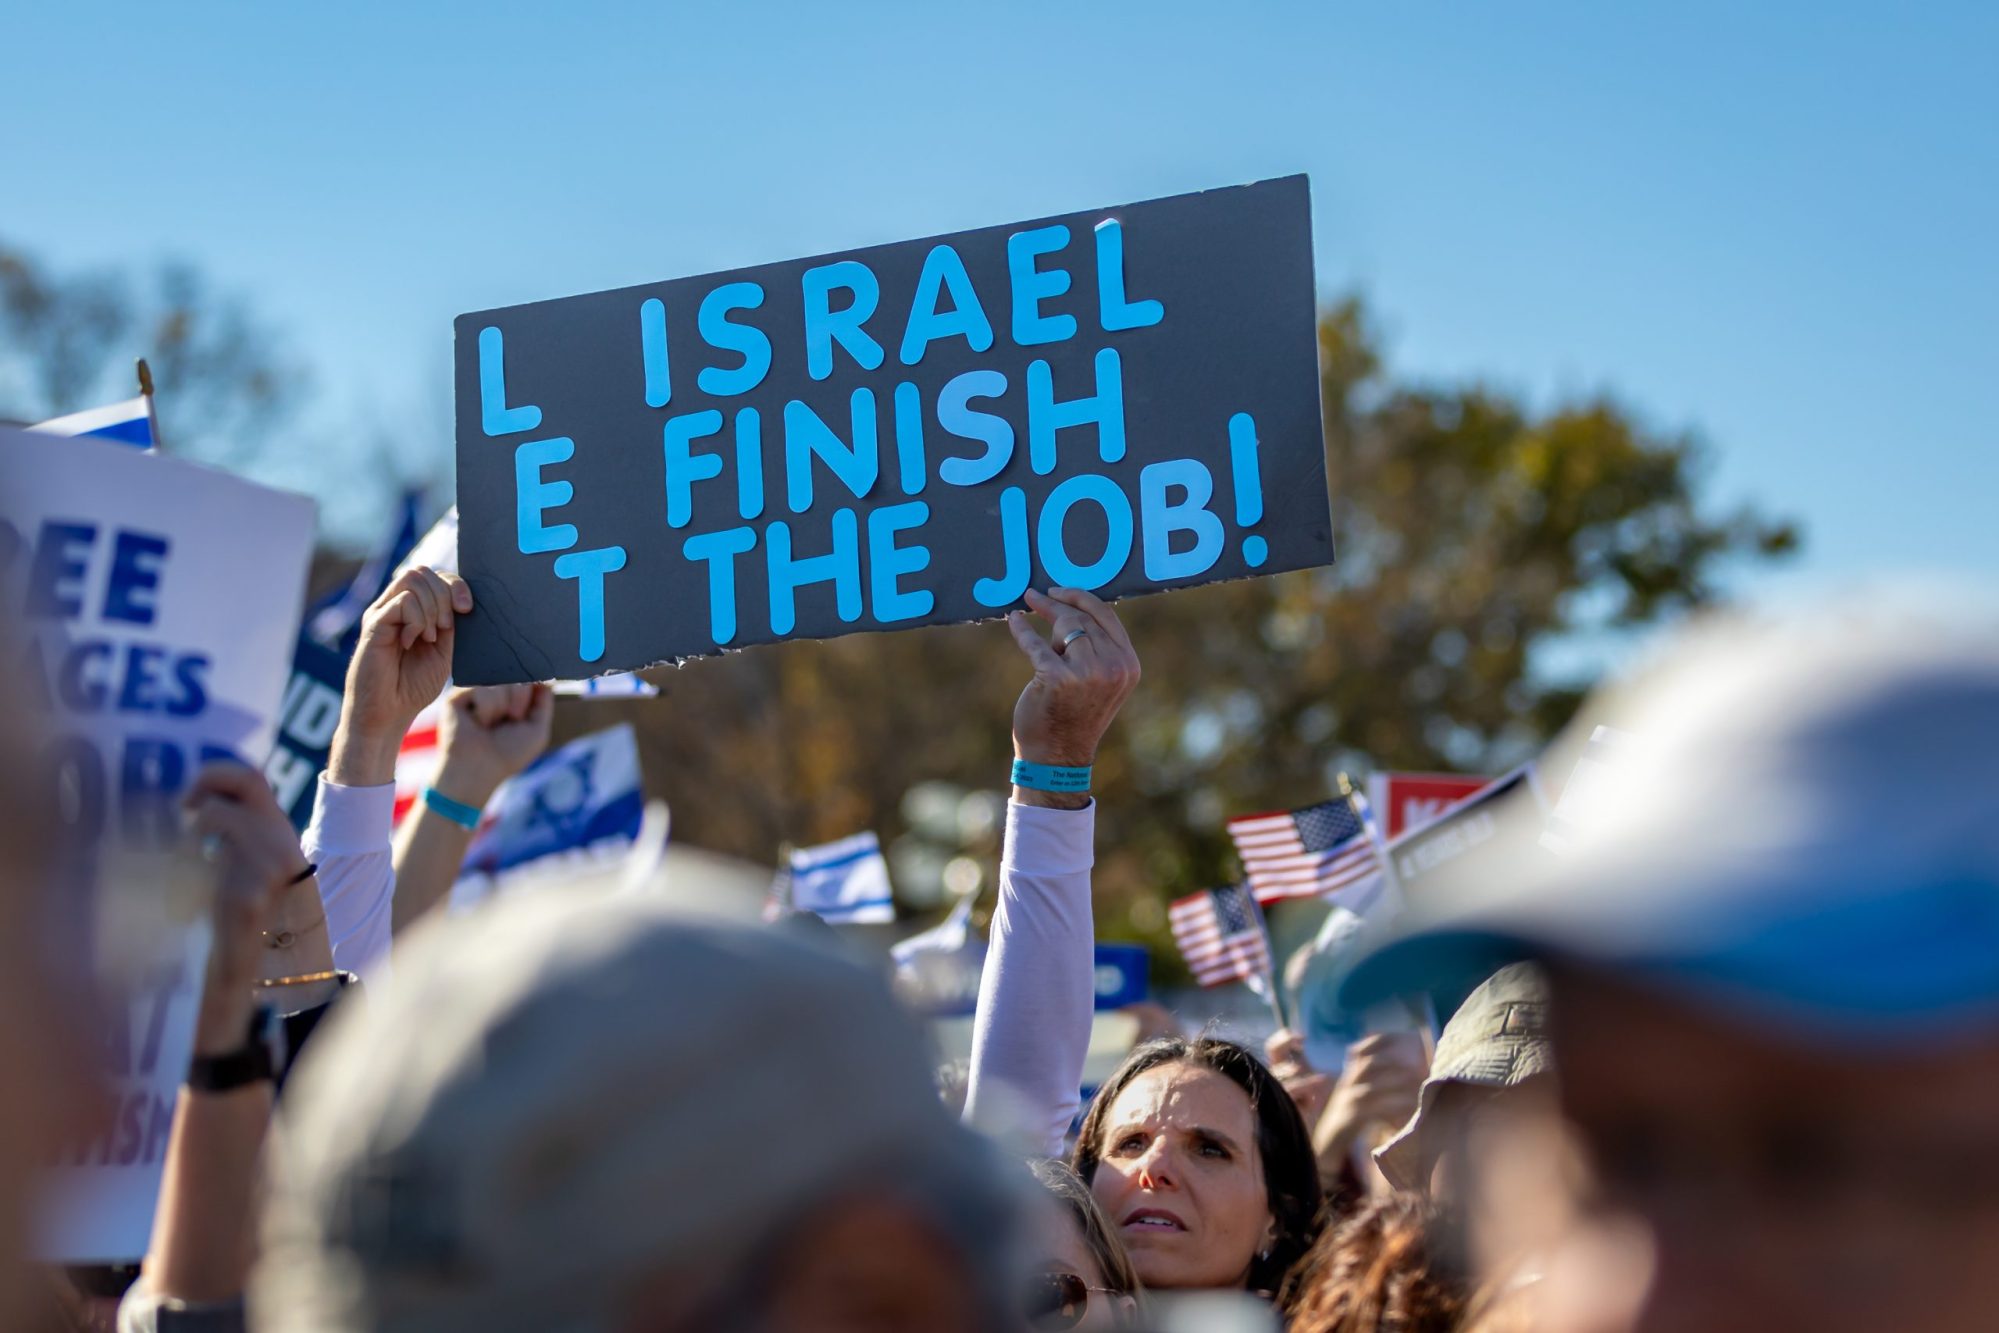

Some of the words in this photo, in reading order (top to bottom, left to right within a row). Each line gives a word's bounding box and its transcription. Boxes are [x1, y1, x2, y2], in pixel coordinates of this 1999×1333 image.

[641, 218, 1163, 407] ISRAEL
[664, 348, 1125, 528] FINISH
[683, 502, 933, 641] THE
[974, 413, 1267, 602] JOB!
[0, 517, 170, 625] EE
